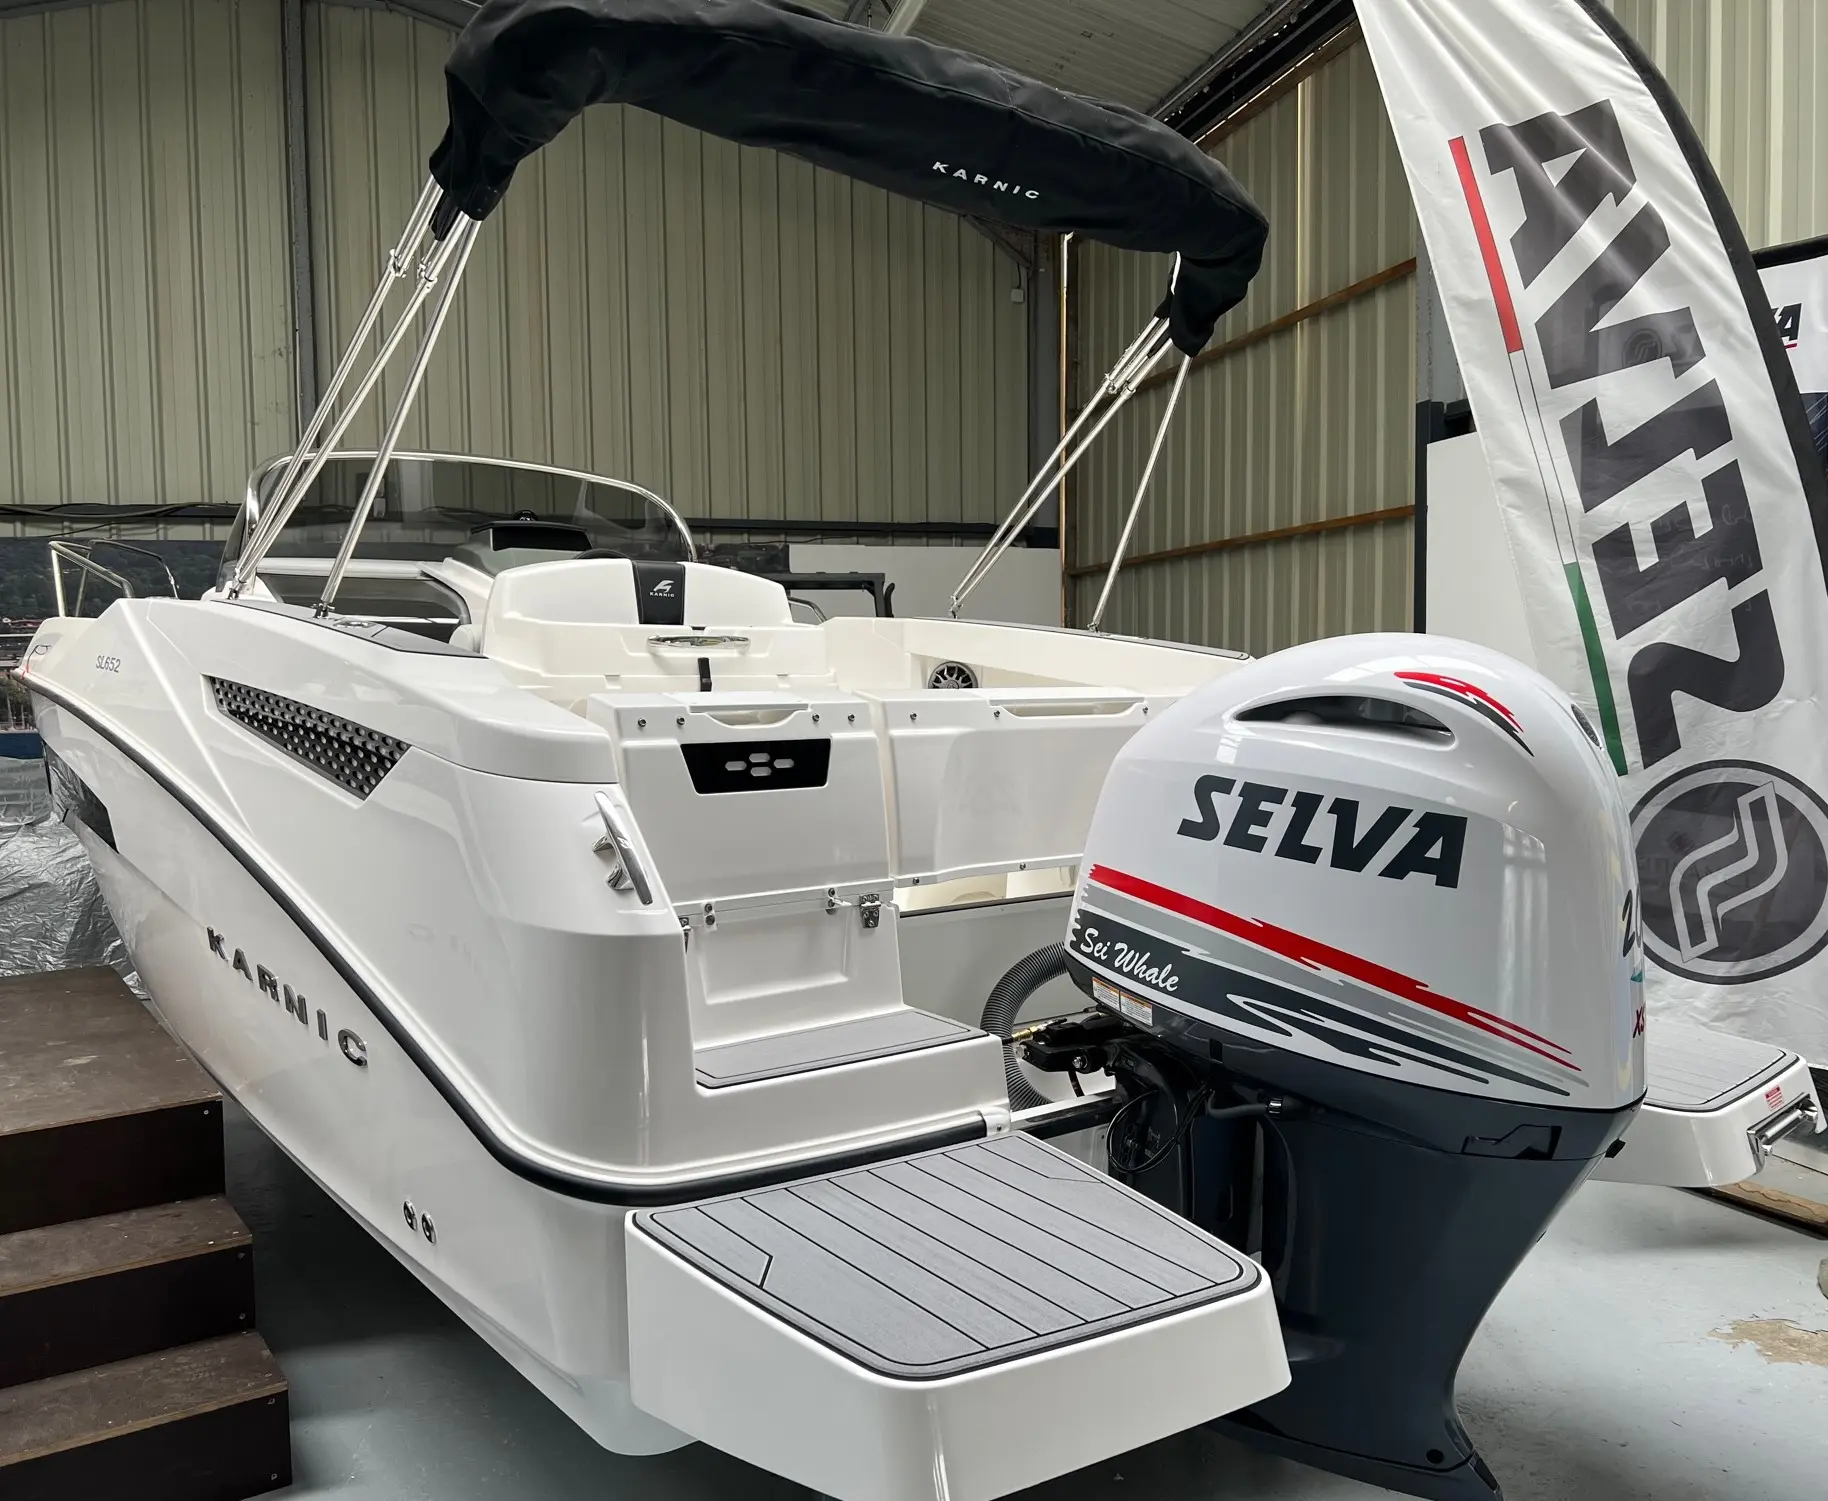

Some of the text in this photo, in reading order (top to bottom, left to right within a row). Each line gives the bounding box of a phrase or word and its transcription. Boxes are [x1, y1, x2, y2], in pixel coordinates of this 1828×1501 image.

[932, 161, 1040, 199] KARNIC
[95, 655, 121, 673] SL652
[1177, 774, 1468, 889] SELVA
[1080, 927, 1179, 992] Sei Whale
[206, 926, 368, 1067] KARNIC
